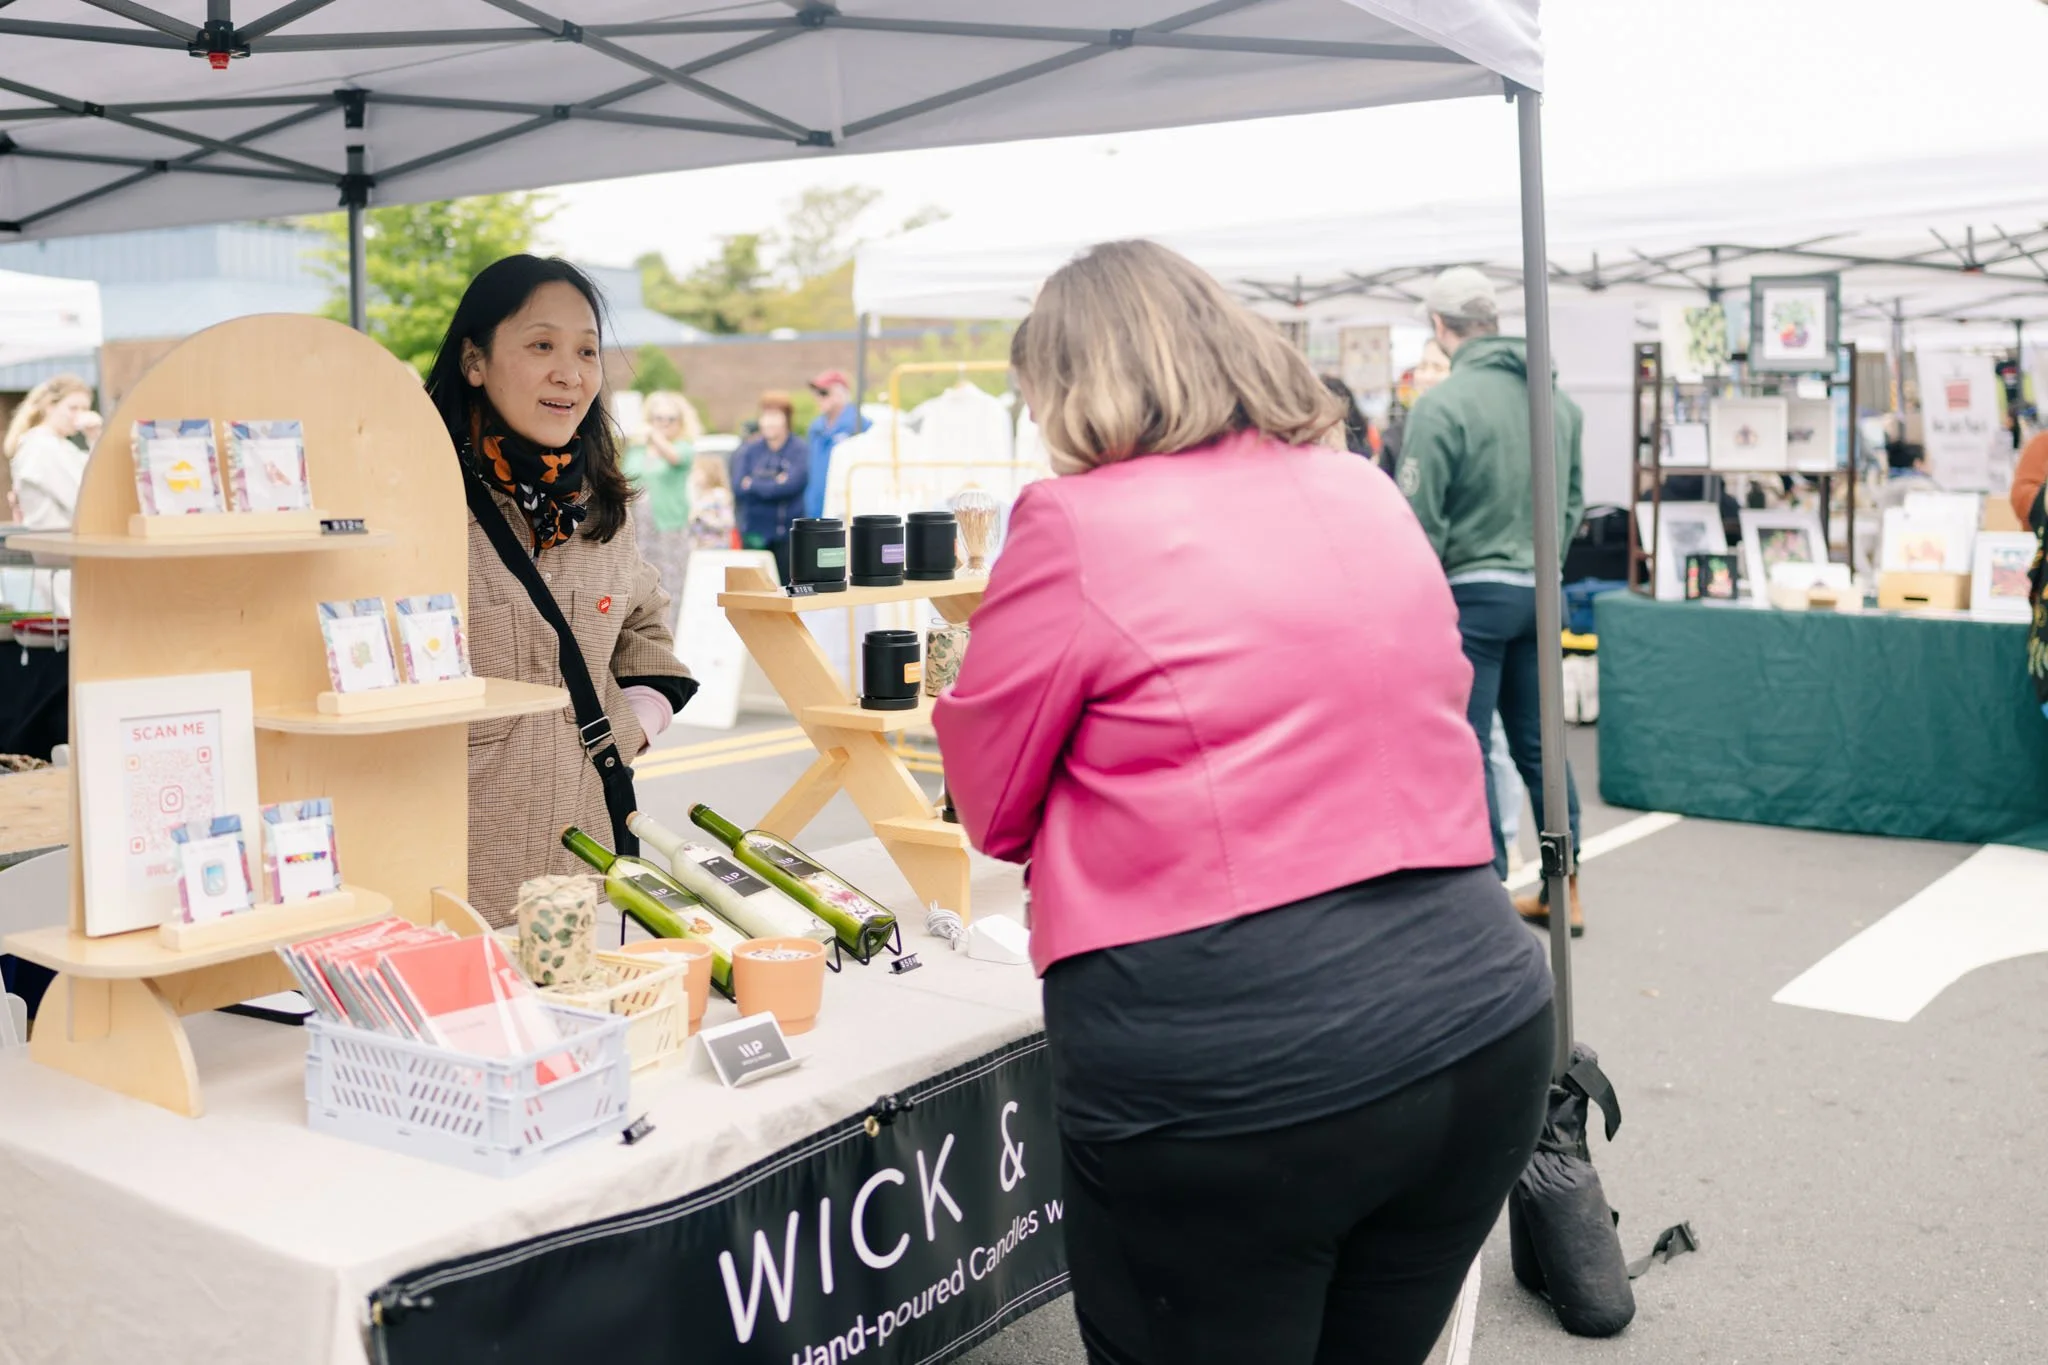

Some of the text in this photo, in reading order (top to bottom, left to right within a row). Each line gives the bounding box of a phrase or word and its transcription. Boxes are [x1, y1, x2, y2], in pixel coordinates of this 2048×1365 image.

[132, 721, 205, 741] SCAN ME
[718, 1101, 1026, 1344] WICK &
[969, 1210, 1039, 1280] Candles
